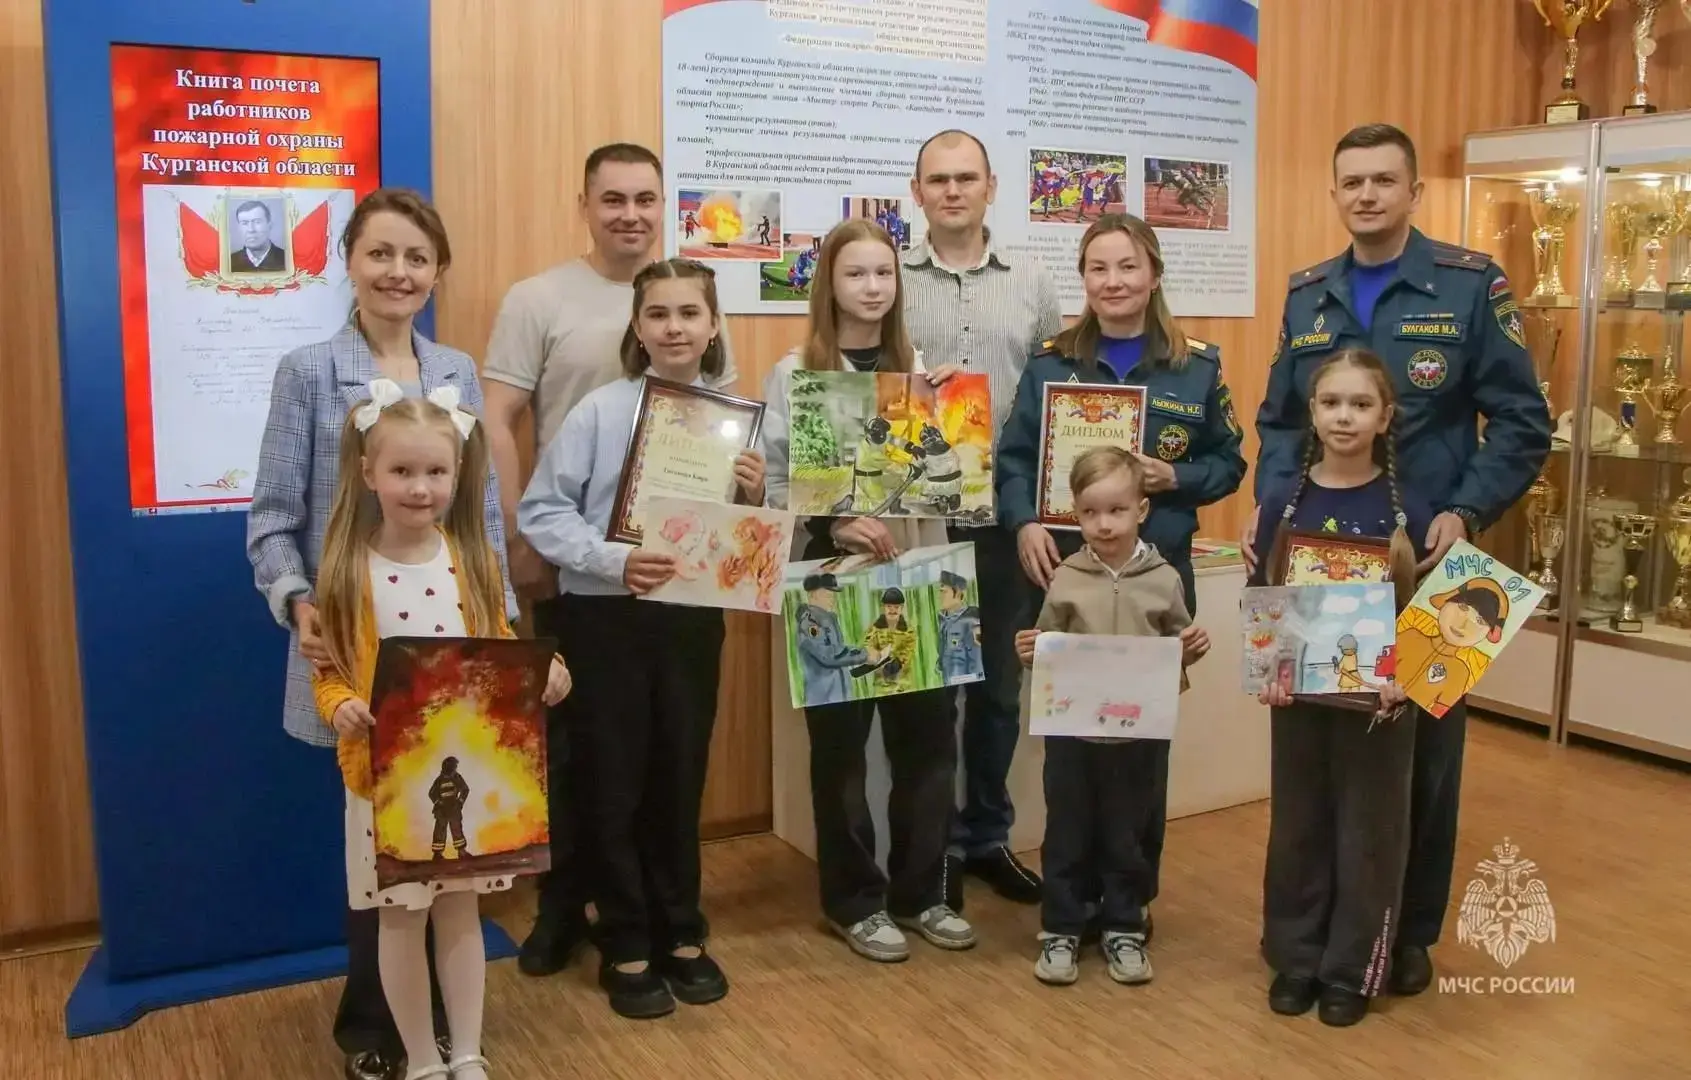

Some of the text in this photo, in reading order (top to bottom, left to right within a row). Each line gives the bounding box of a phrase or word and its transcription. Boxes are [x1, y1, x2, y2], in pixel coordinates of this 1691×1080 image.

[704, 52, 739, 63] Сборная
[175, 69, 320, 94] Книга почета
[676, 87, 712, 96] области
[187, 99, 311, 121] работников
[676, 100, 709, 110] спорта
[153, 129, 344, 151] пожарной охраны
[141, 152, 355, 176] Курганской области
[713, 160, 758, 172] Курганской
[759, 162, 793, 172] области
[676, 171, 719, 182] аппарата
[720, 171, 734, 181] для
[1401, 324, 1459, 335] БУЛГАКОВ М.А.
[1061, 425, 1124, 440] ДИПЛОМ
[1445, 554, 1494, 580] МЧС
